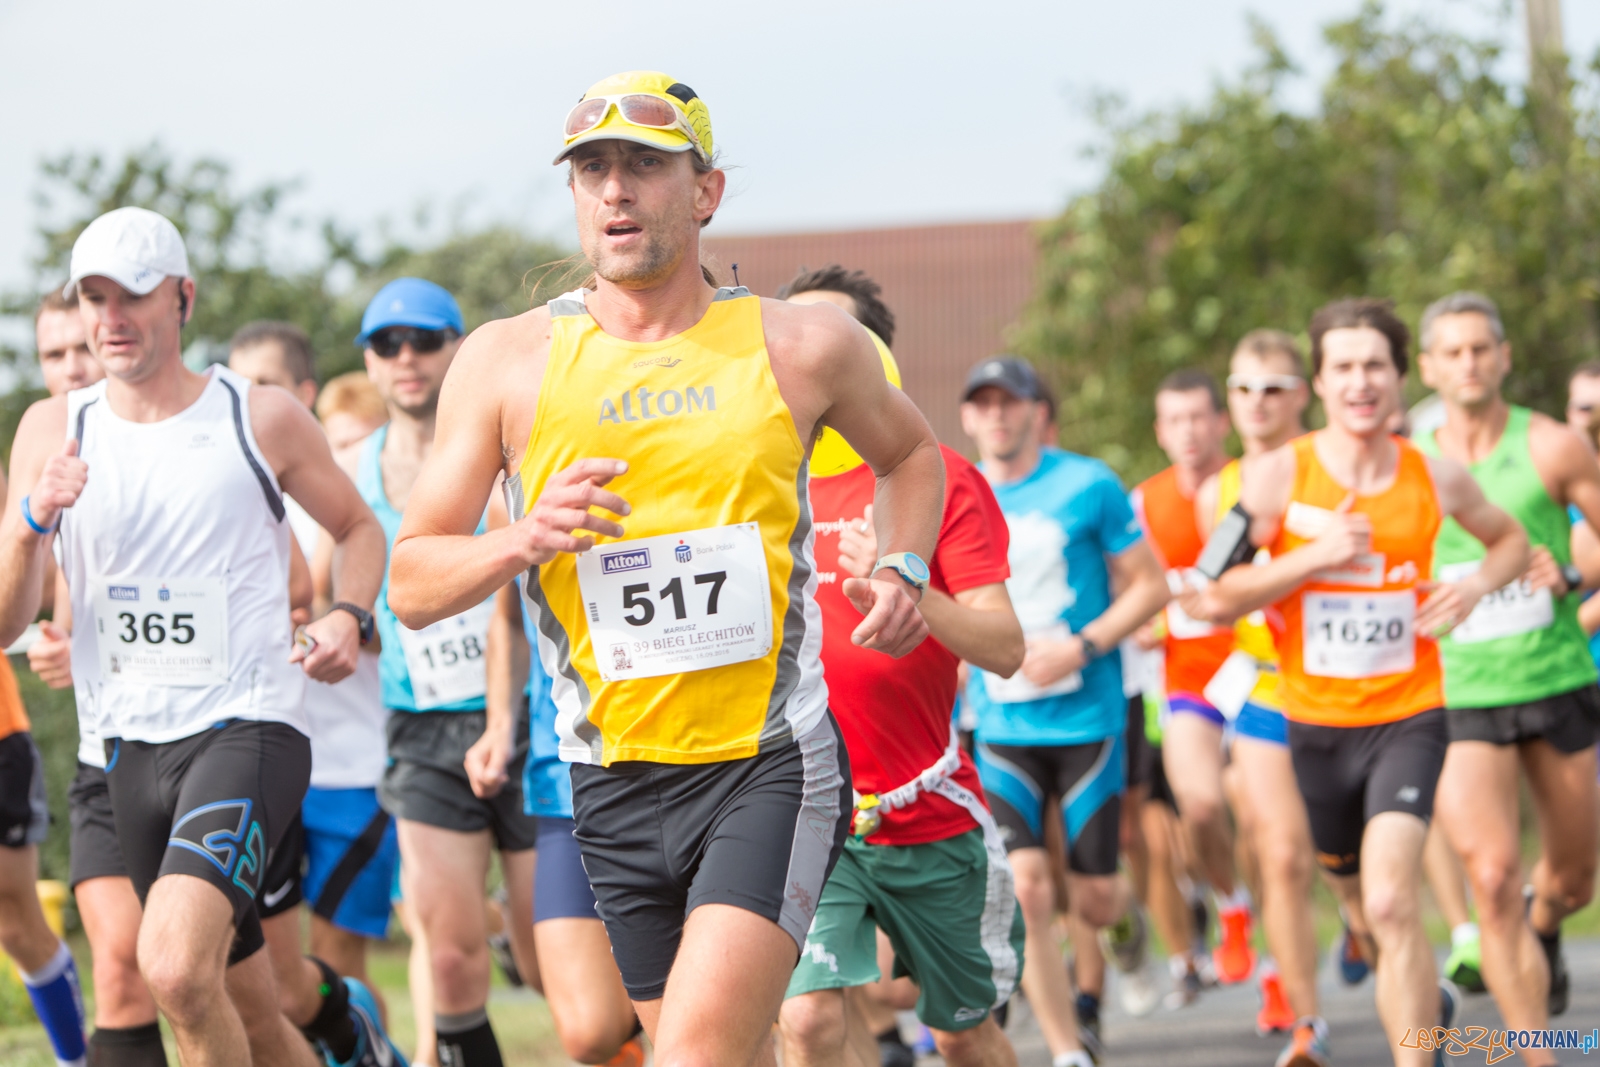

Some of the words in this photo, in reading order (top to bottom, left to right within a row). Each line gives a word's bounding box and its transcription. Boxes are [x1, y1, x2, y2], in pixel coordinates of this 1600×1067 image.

[633, 356, 672, 369] saucony
[623, 570, 727, 626] 517
[118, 611, 195, 645] 365
[633, 641, 649, 653] 39
[653, 635, 685, 650] BIEG
[689, 622, 756, 645] LECHITÓW
[664, 624, 697, 634] MARIUSZ
[1320, 617, 1404, 643] 1620
[423, 634, 482, 668] 158
